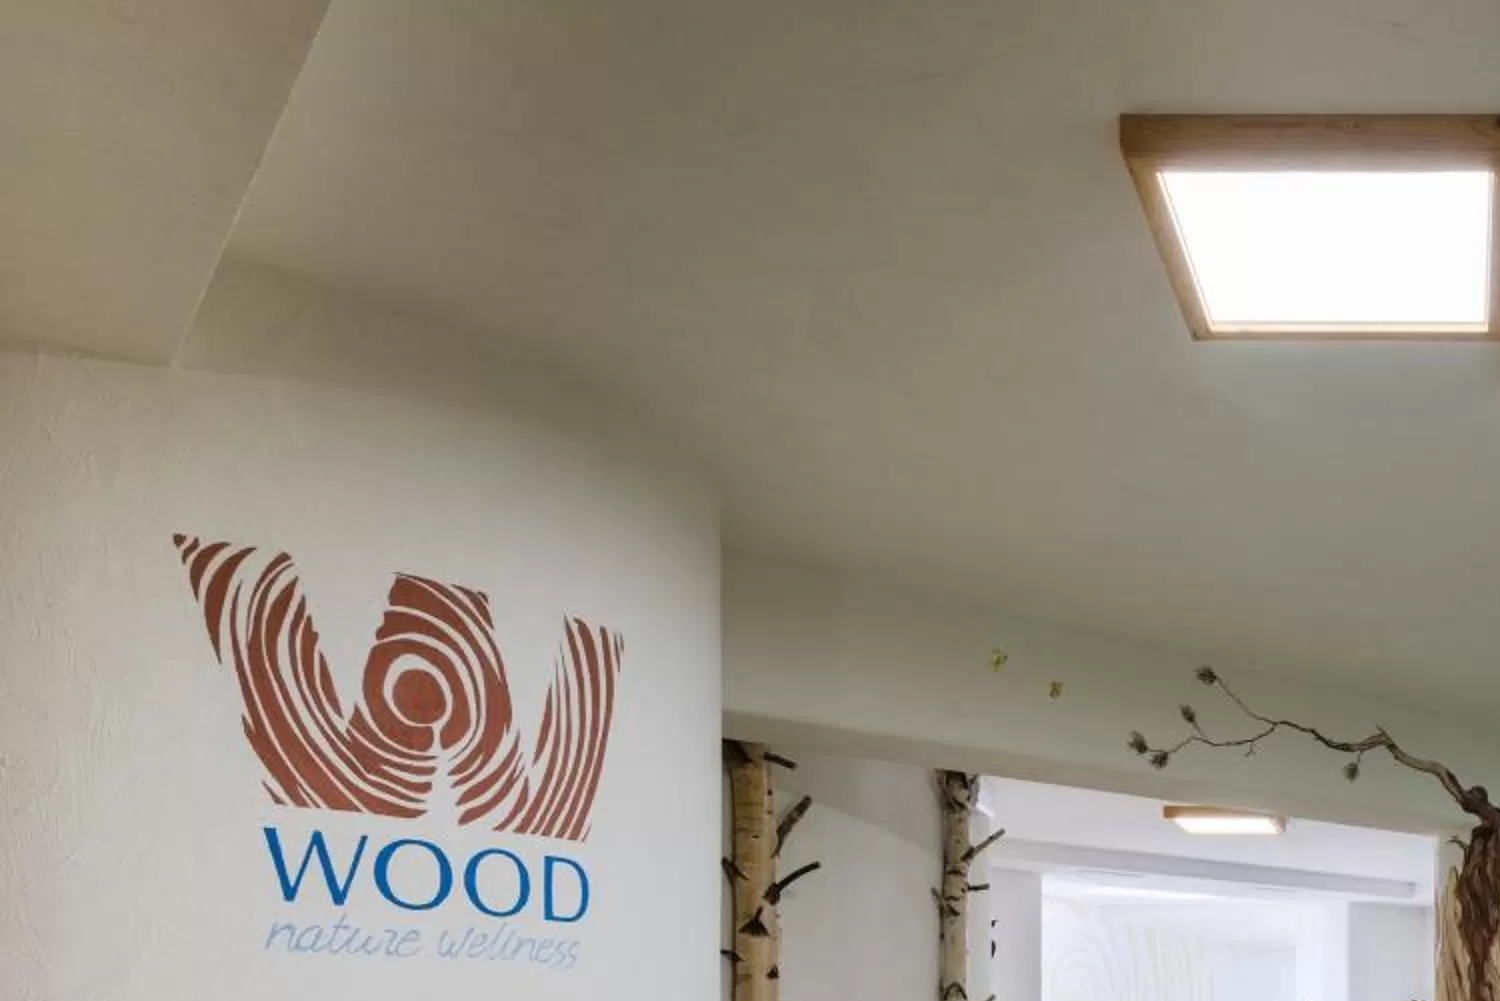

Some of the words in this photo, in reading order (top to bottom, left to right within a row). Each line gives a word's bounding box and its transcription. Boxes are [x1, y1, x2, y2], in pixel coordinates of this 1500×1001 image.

[263, 827, 590, 923] WOOD
[264, 914, 423, 958] nature
[437, 922, 581, 967] wellness
